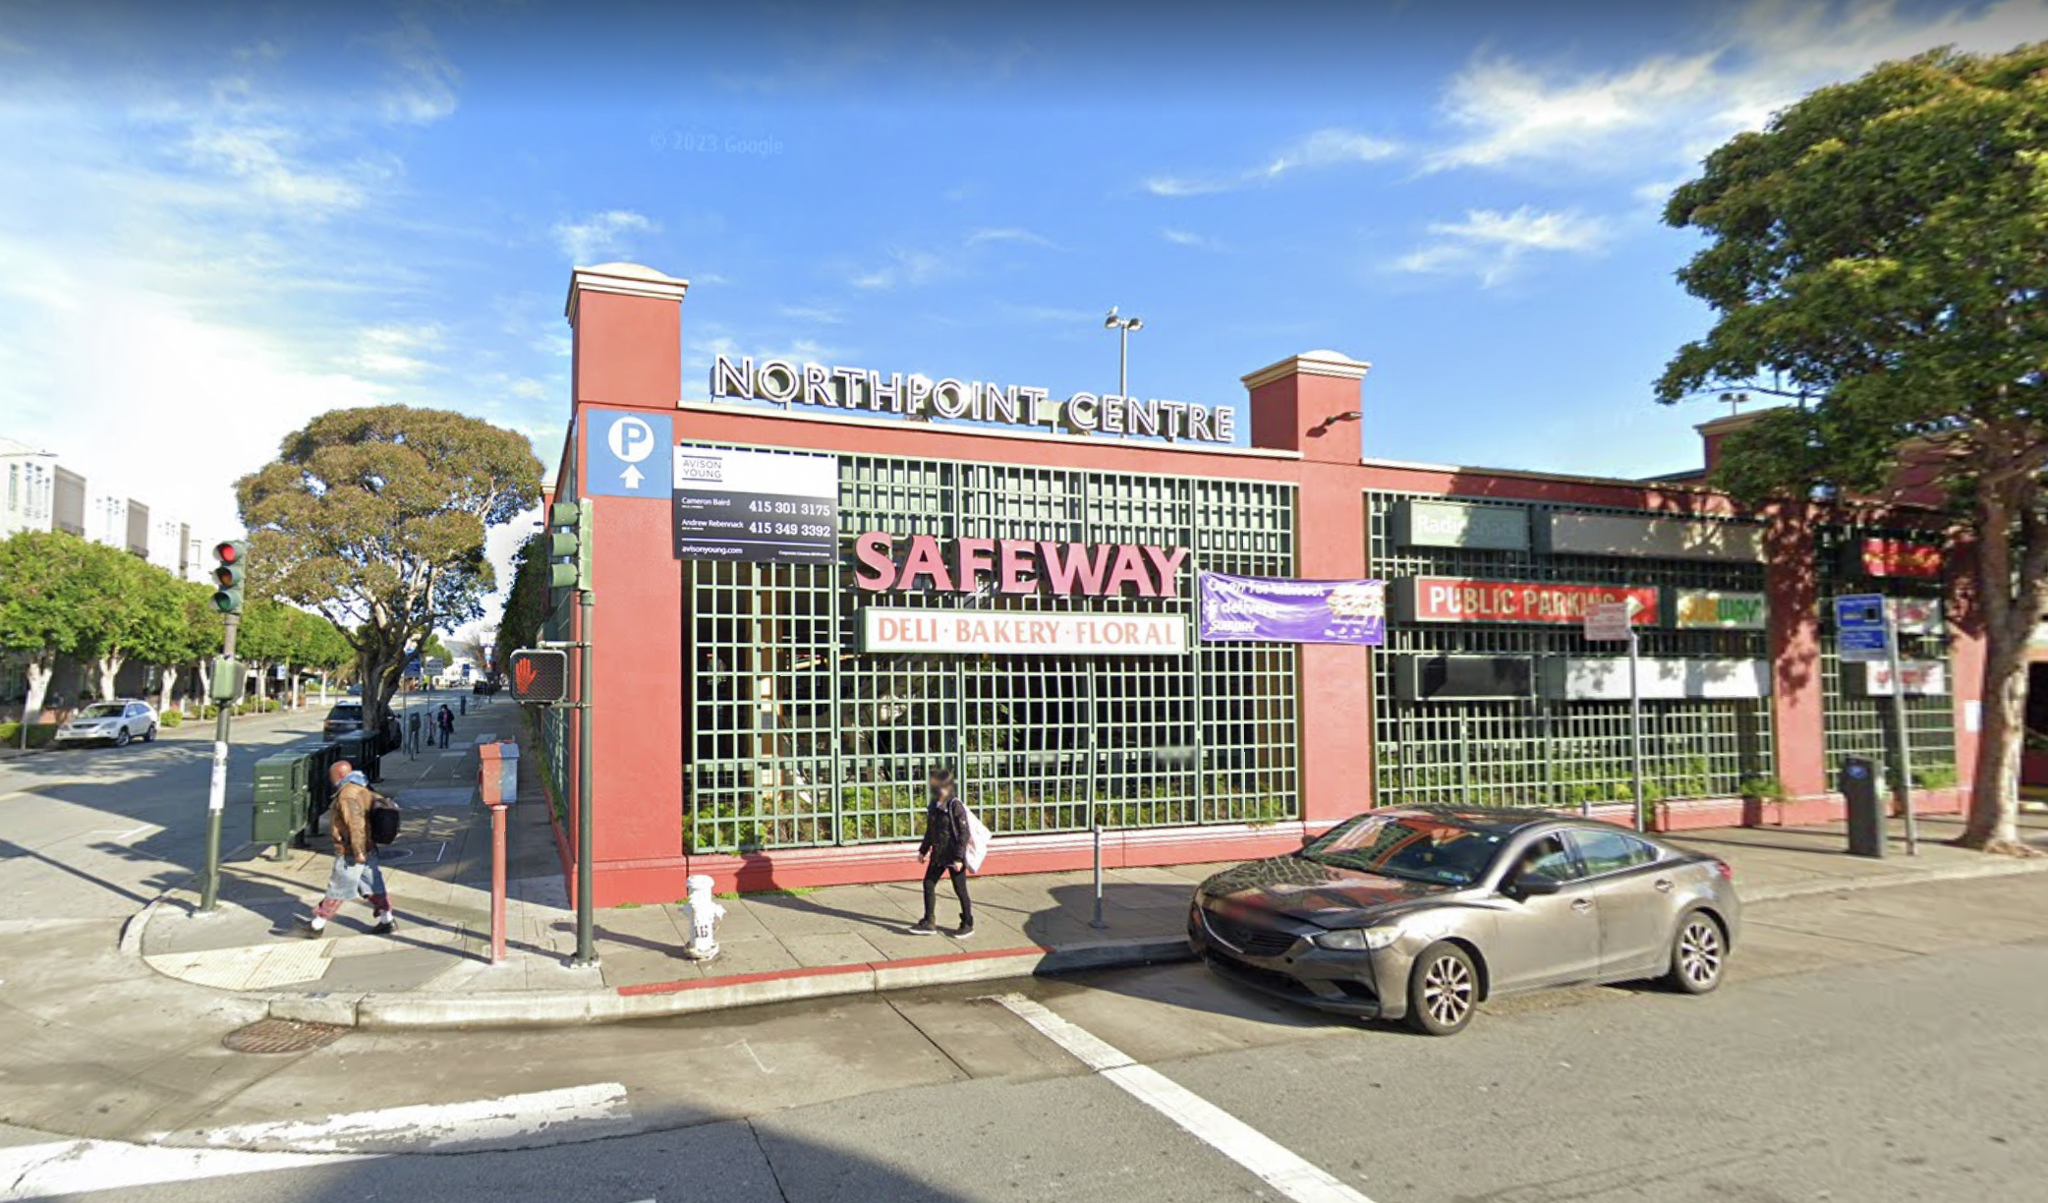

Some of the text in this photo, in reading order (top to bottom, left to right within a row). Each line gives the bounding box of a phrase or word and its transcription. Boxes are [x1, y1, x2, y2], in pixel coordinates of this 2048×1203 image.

[713, 354, 1235, 442] NORTHPOINT CENTRE
[621, 423, 647, 456] P
[683, 459, 722, 469] AVISON
[683, 468, 722, 478] YOUNG
[682, 497, 731, 506] Cameron Baird
[749, 500, 830, 516] 415 301 3175
[682, 519, 708, 528] Andrew
[749, 522, 831, 538] 415 349 3392
[682, 545, 743, 555] avisonyoung.com
[855, 531, 1189, 597] SAFEWAY
[1430, 586, 1516, 614] PUBLIC
[878, 617, 1176, 645] DELI BAKERY FLORAL
